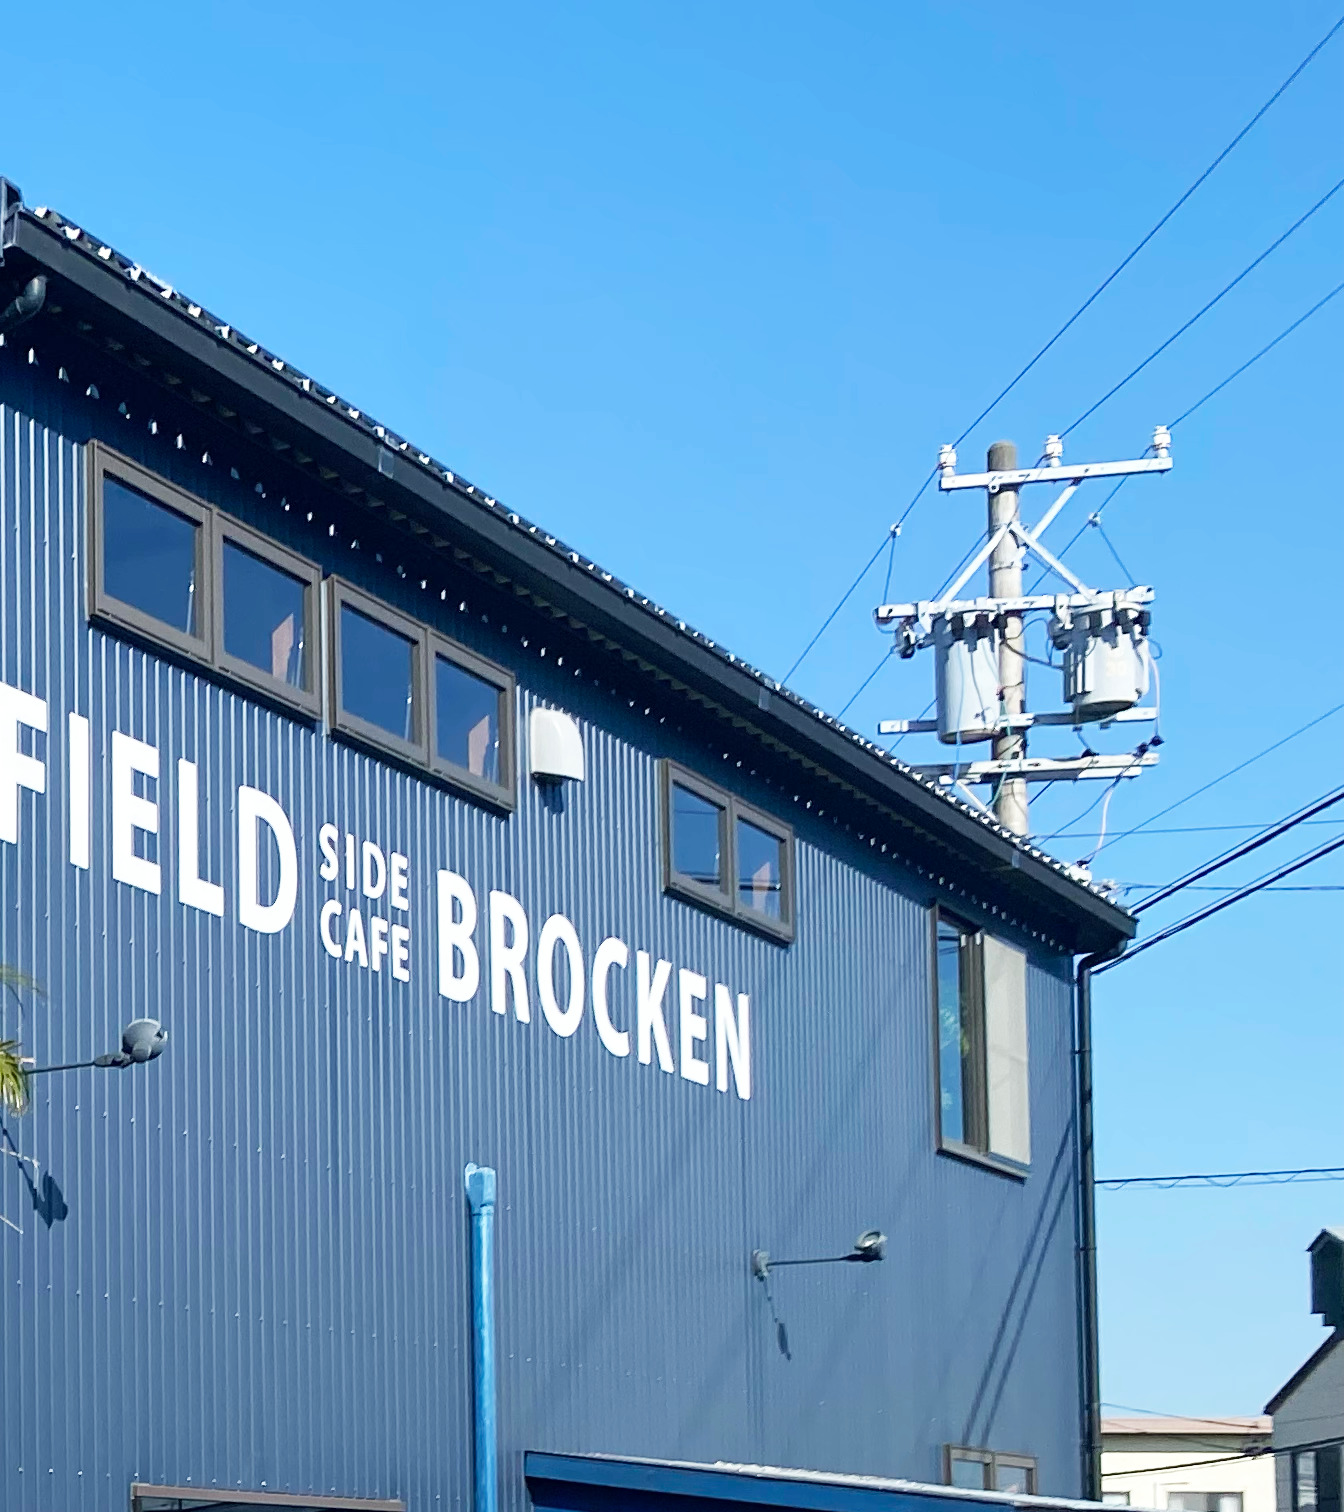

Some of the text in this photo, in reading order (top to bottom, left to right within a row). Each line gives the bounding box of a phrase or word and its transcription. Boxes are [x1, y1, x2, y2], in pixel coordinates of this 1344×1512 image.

[319, 823, 410, 912] SIDE
[319, 899, 411, 984] CAFE
[437, 868, 752, 1101] BROCKEN
